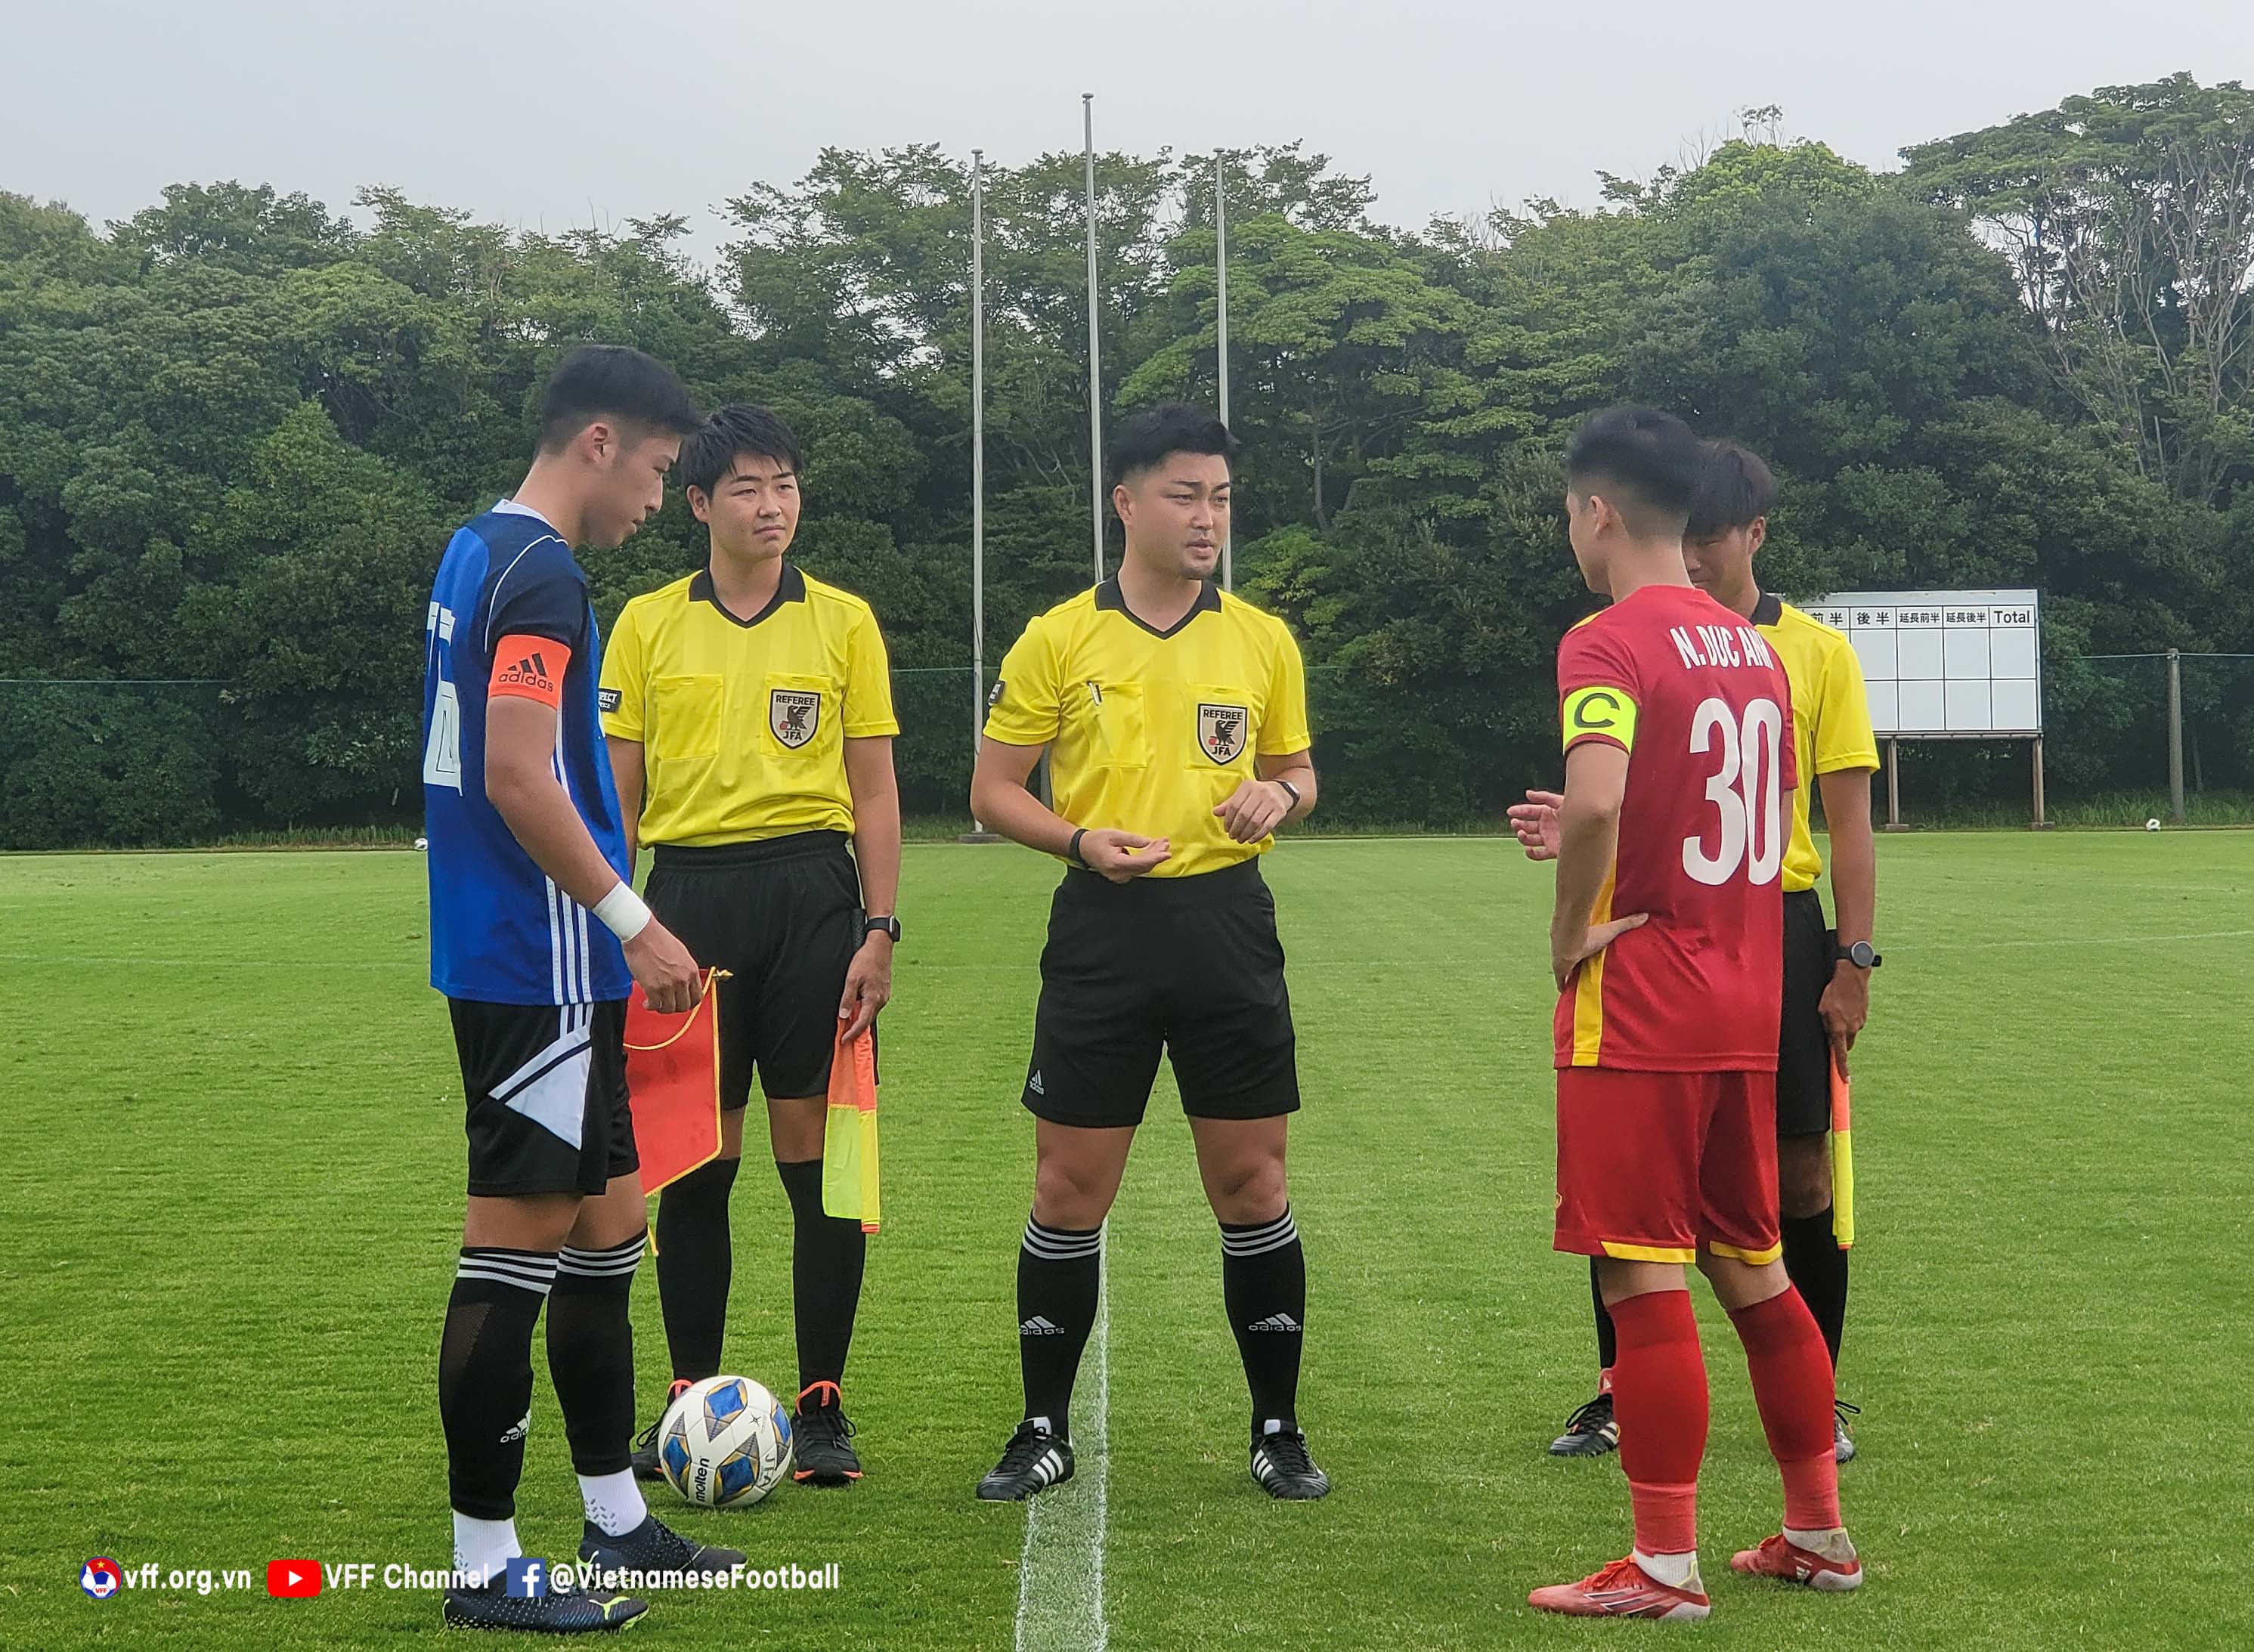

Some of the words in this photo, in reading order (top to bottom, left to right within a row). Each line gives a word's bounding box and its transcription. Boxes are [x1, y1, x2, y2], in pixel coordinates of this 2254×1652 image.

[1856, 611, 1889, 625] 後半
[1899, 613, 1940, 623] 延長前半
[1946, 612, 1986, 623] 延長後半
[1993, 611, 2030, 623] Total
[499, 671, 553, 692] adidas
[776, 695, 816, 706] REFEREE
[1203, 709, 1243, 719] REFEREE
[1574, 692, 1621, 729] C
[782, 731, 803, 741] JFA
[1212, 746, 1231, 756] JFA
[1682, 697, 1782, 886] 30
[695, 1457, 710, 1502] molten
